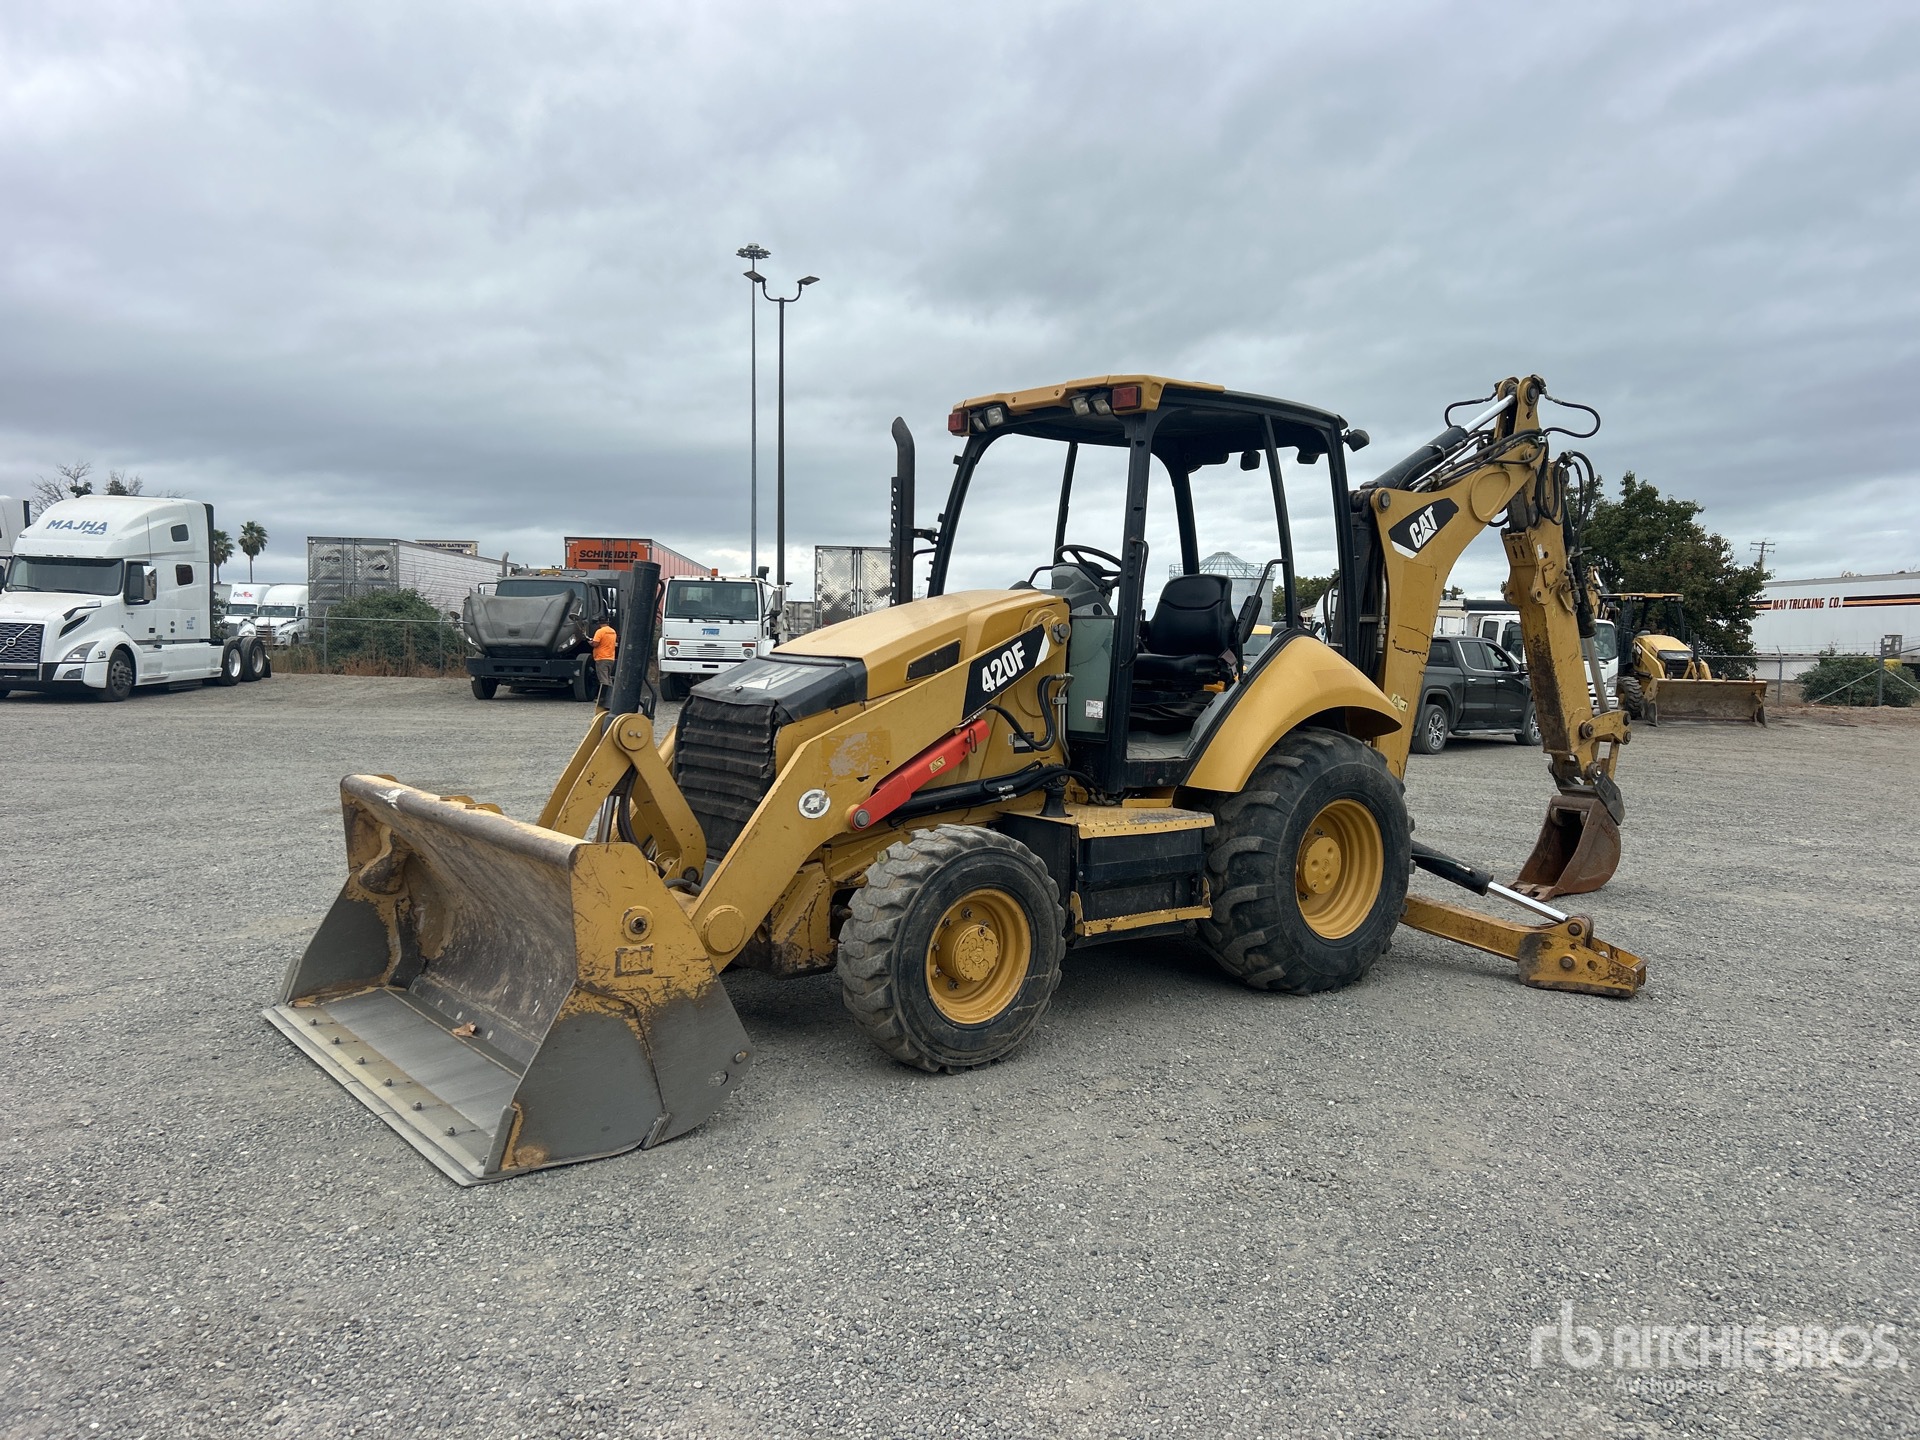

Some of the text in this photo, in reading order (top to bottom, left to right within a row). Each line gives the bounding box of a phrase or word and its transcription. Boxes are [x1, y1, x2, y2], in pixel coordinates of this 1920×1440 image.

[46, 520, 107, 531] MAJHA
[1409, 505, 1438, 548] CAT
[579, 550, 638, 559] SCHNEIDER
[1772, 597, 1841, 610] MAY TRUCKING CO.
[982, 640, 1026, 692] 420F
